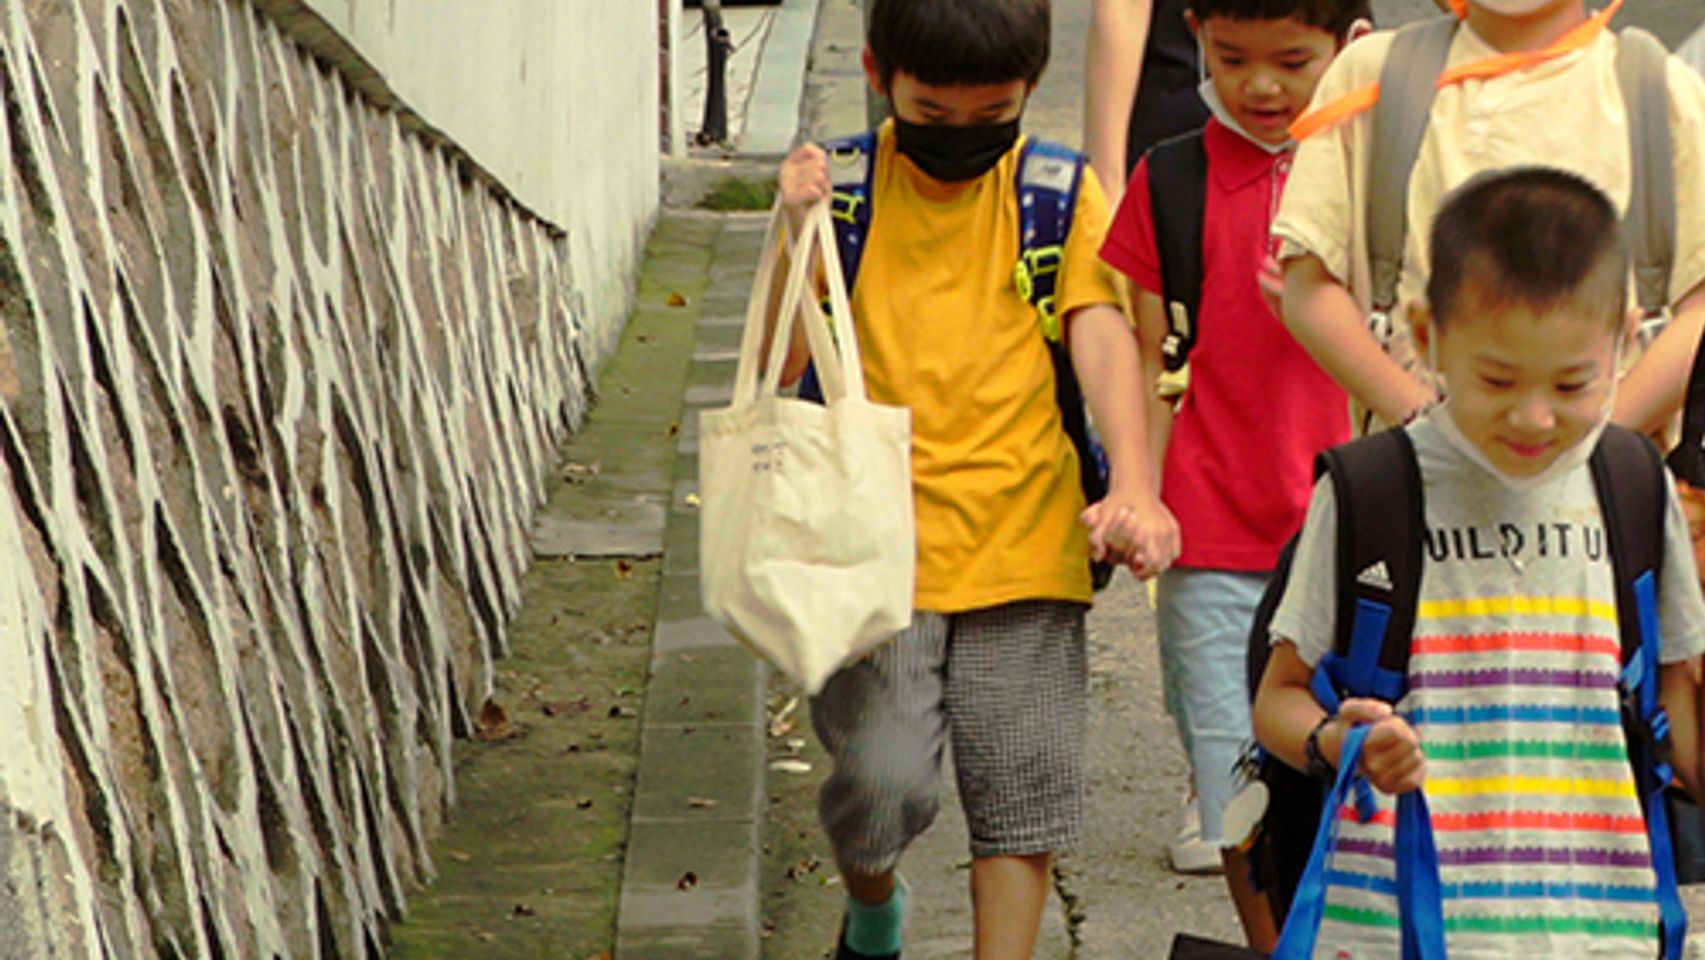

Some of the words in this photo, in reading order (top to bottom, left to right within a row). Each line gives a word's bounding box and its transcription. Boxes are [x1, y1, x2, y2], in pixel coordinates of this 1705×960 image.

[1423, 523, 1525, 562] UILD
[1537, 523, 1572, 558] IT
[1582, 526, 1602, 562] U
